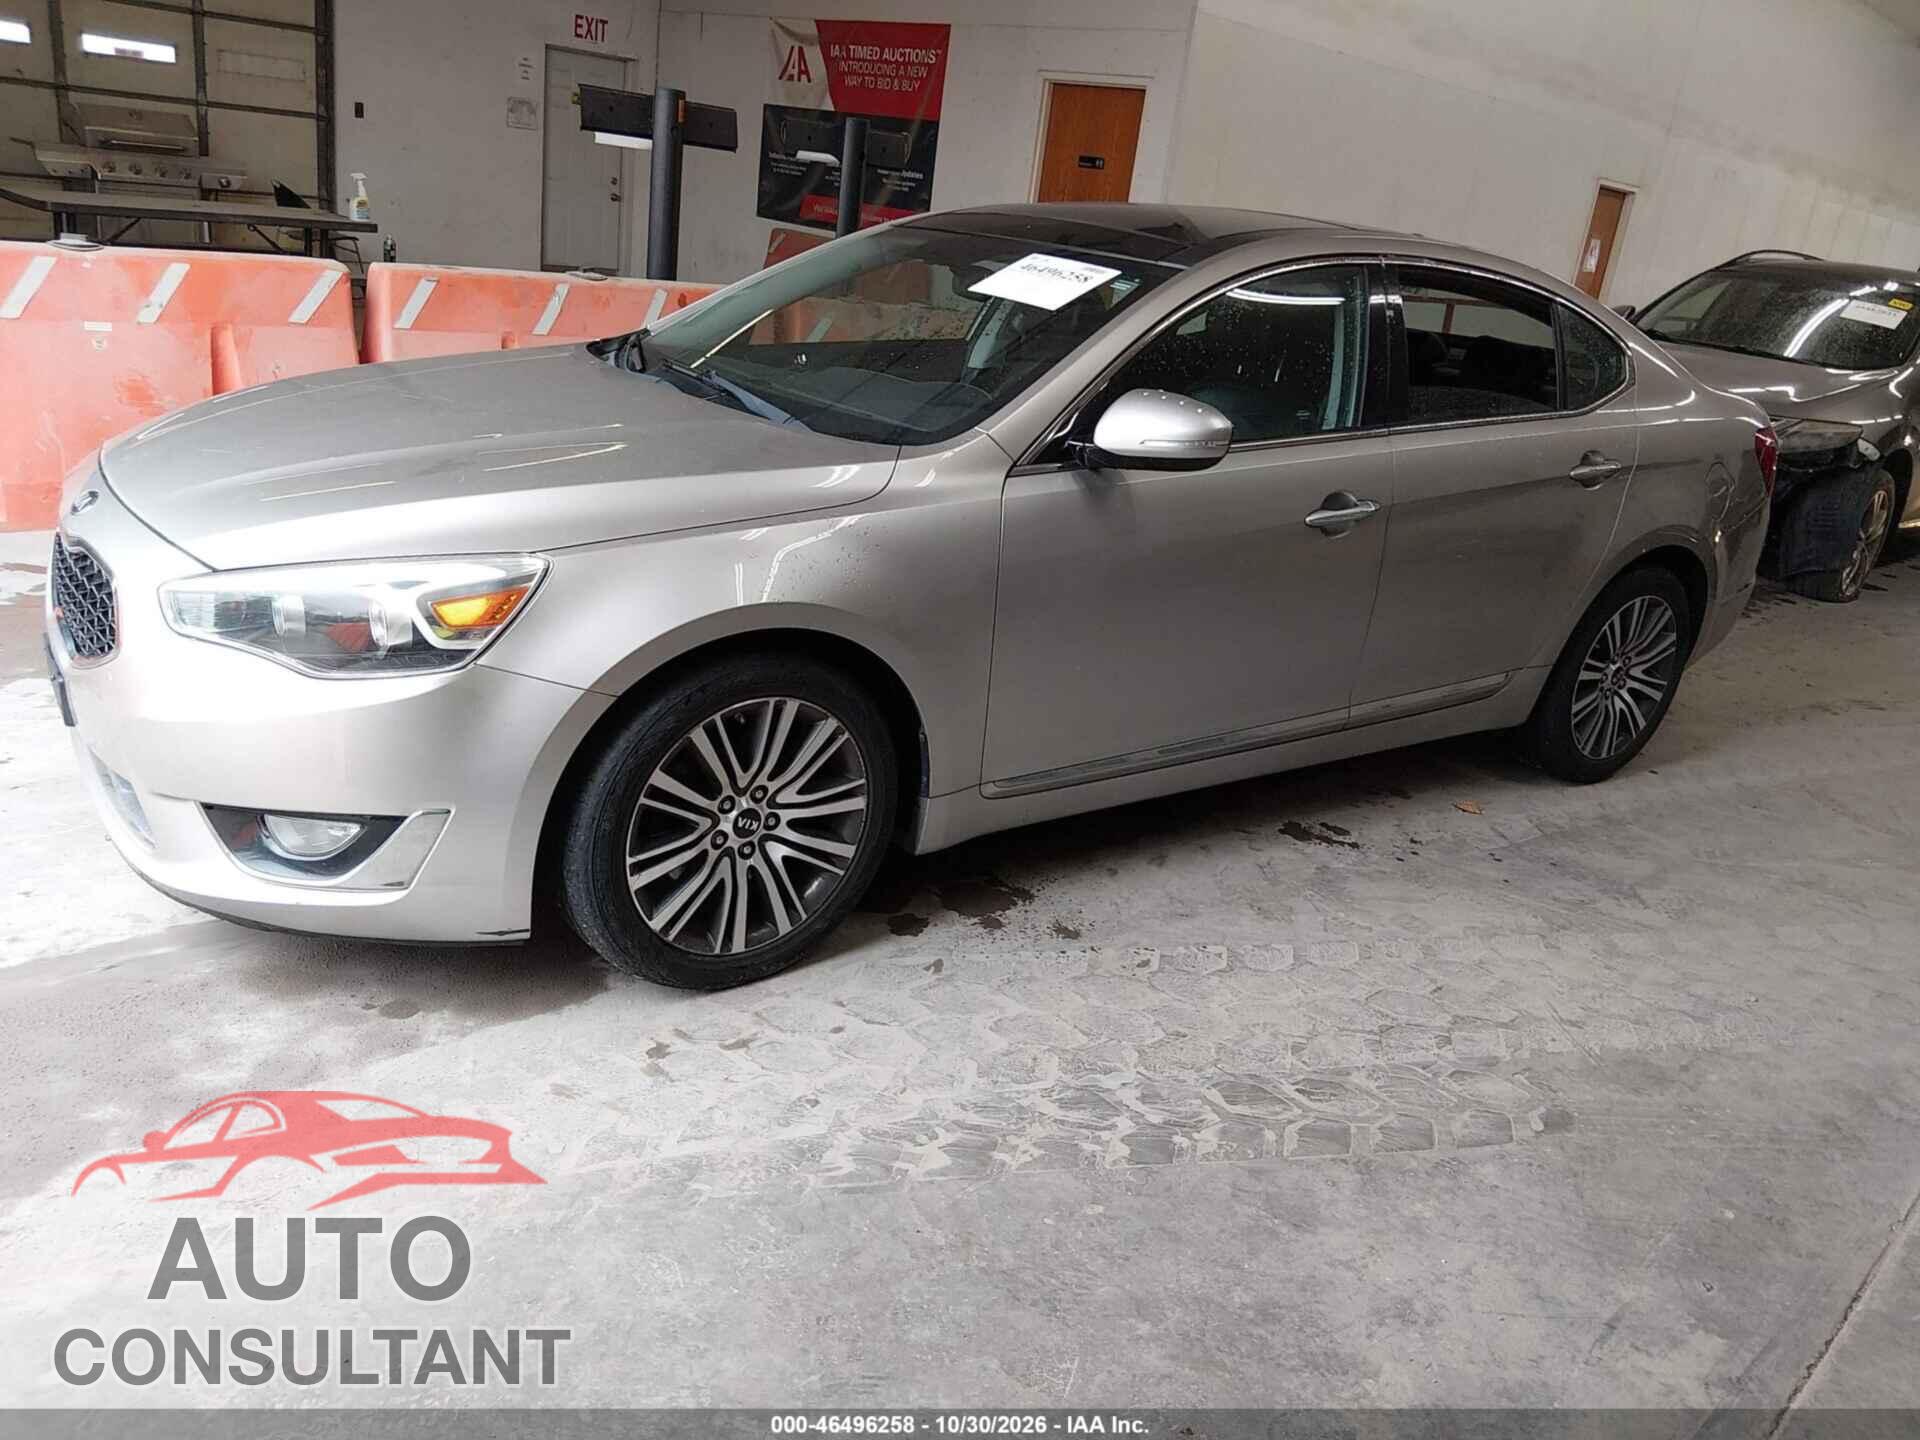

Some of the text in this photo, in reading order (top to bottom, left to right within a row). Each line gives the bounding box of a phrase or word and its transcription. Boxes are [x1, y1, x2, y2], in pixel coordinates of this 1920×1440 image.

[573, 14, 609, 43] EXIT
[848, 45, 881, 62] TIMED
[838, 61, 929, 78] INTRODUCING A NEW
[844, 75, 863, 88] WAY
[864, 76, 875, 89] TO
[876, 77, 891, 90] BID
[901, 80, 921, 93] BUY
